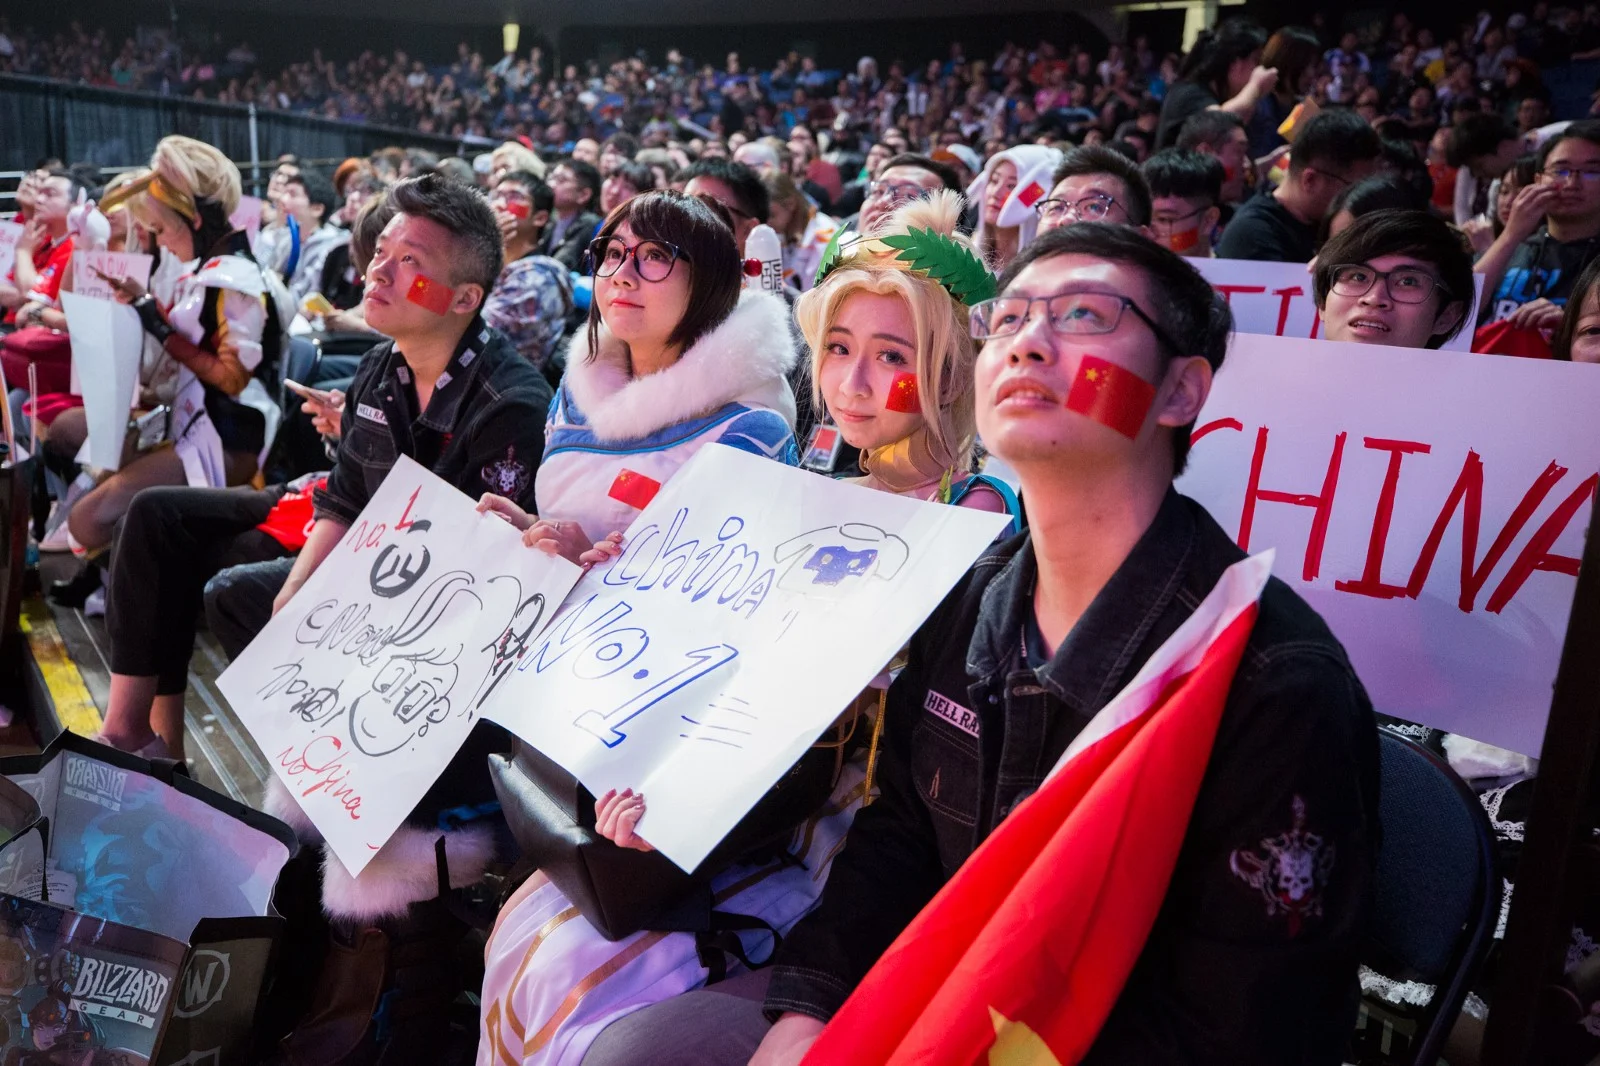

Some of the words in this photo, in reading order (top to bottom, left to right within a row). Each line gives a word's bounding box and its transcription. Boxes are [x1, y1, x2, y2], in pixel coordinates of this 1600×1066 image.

[926, 692, 959, 723] HELL
[959, 711, 980, 736] RA
[72, 957, 169, 1014] BLIZZARD
[79, 1002, 145, 1024] GEAR
